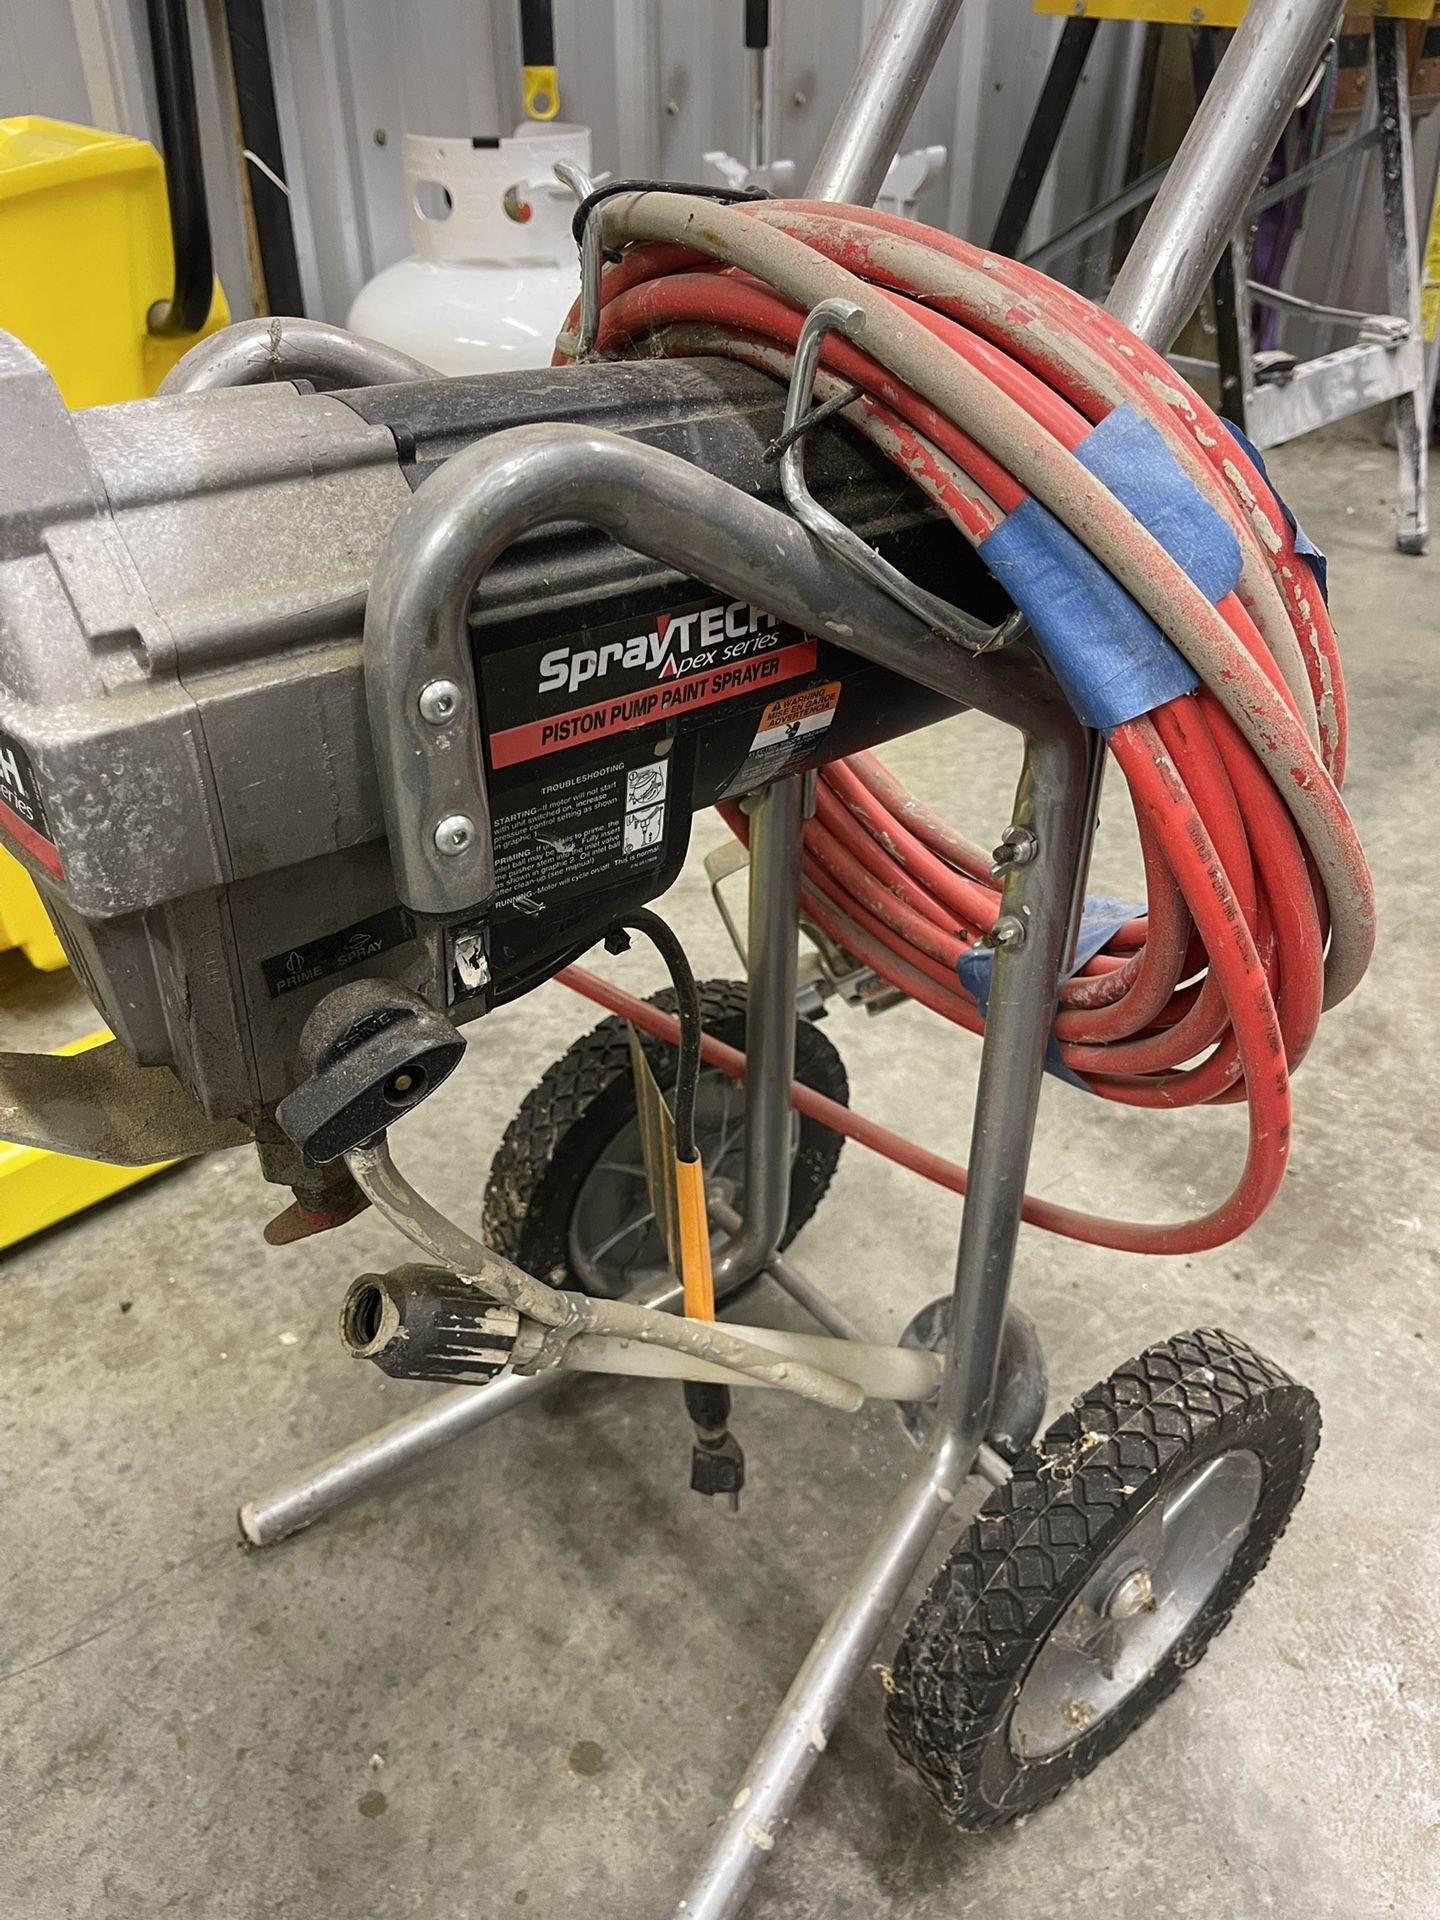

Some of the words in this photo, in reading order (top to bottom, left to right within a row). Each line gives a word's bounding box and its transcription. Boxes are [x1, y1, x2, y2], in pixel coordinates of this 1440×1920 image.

[658, 651, 721, 679] Apex
[722, 631, 780, 661] series
[541, 708, 608, 746] PISTON
[609, 696, 658, 726] PUMP
[660, 679, 710, 710] PAINT
[711, 657, 780, 694] SPRAYER
[767, 706, 789, 720] MISE
[791, 702, 804, 714] EN
[805, 692, 836, 708] GARDE
[768, 702, 829, 727] ADVERTENCIA
[784, 688, 825, 708] WARNING
[541, 762, 625, 795] TROUBLESHOOTING
[549, 797, 571, 809] motor
[572, 792, 585, 801] will
[586, 787, 599, 797] not
[600, 781, 617, 792] start
[494, 825, 510, 835] with
[511, 820, 526, 829] unit
[528, 808, 561, 824] switched
[576, 793, 607, 807] increase
[494, 827, 528, 845] pressure
[529, 817, 555, 831] control
[557, 809, 582, 822] setting
[583, 806, 592, 814] as
[594, 797, 618, 810] shown
[607, 820, 619, 828] the
[494, 873, 507, 881] the
[508, 864, 534, 878] pusher
[536, 857, 555, 867] stem
[556, 851, 570, 860] into
[571, 847, 583, 855] the
[585, 840, 600, 851] inlet
[601, 835, 620, 844] valve
[503, 834, 532, 849] graphic
[512, 858, 526, 869] ball
[527, 853, 544, 864] may
[545, 849, 555, 857] be
[581, 834, 599, 844] Fully
[600, 826, 621, 837] insert
[506, 873, 531, 886] shown
[540, 860, 568, 874] graphic
[579, 850, 590, 859] Oil
[592, 846, 607, 855] inlet
[608, 840, 621, 850] ball
[559, 878, 571, 886] will
[571, 871, 589, 882] cycle
[495, 886, 512, 897] after
[514, 875, 547, 891] clean-up
[547, 868, 564, 879] (see
[276, 966, 323, 994] PRIME
[337, 939, 383, 966] SPRAY
